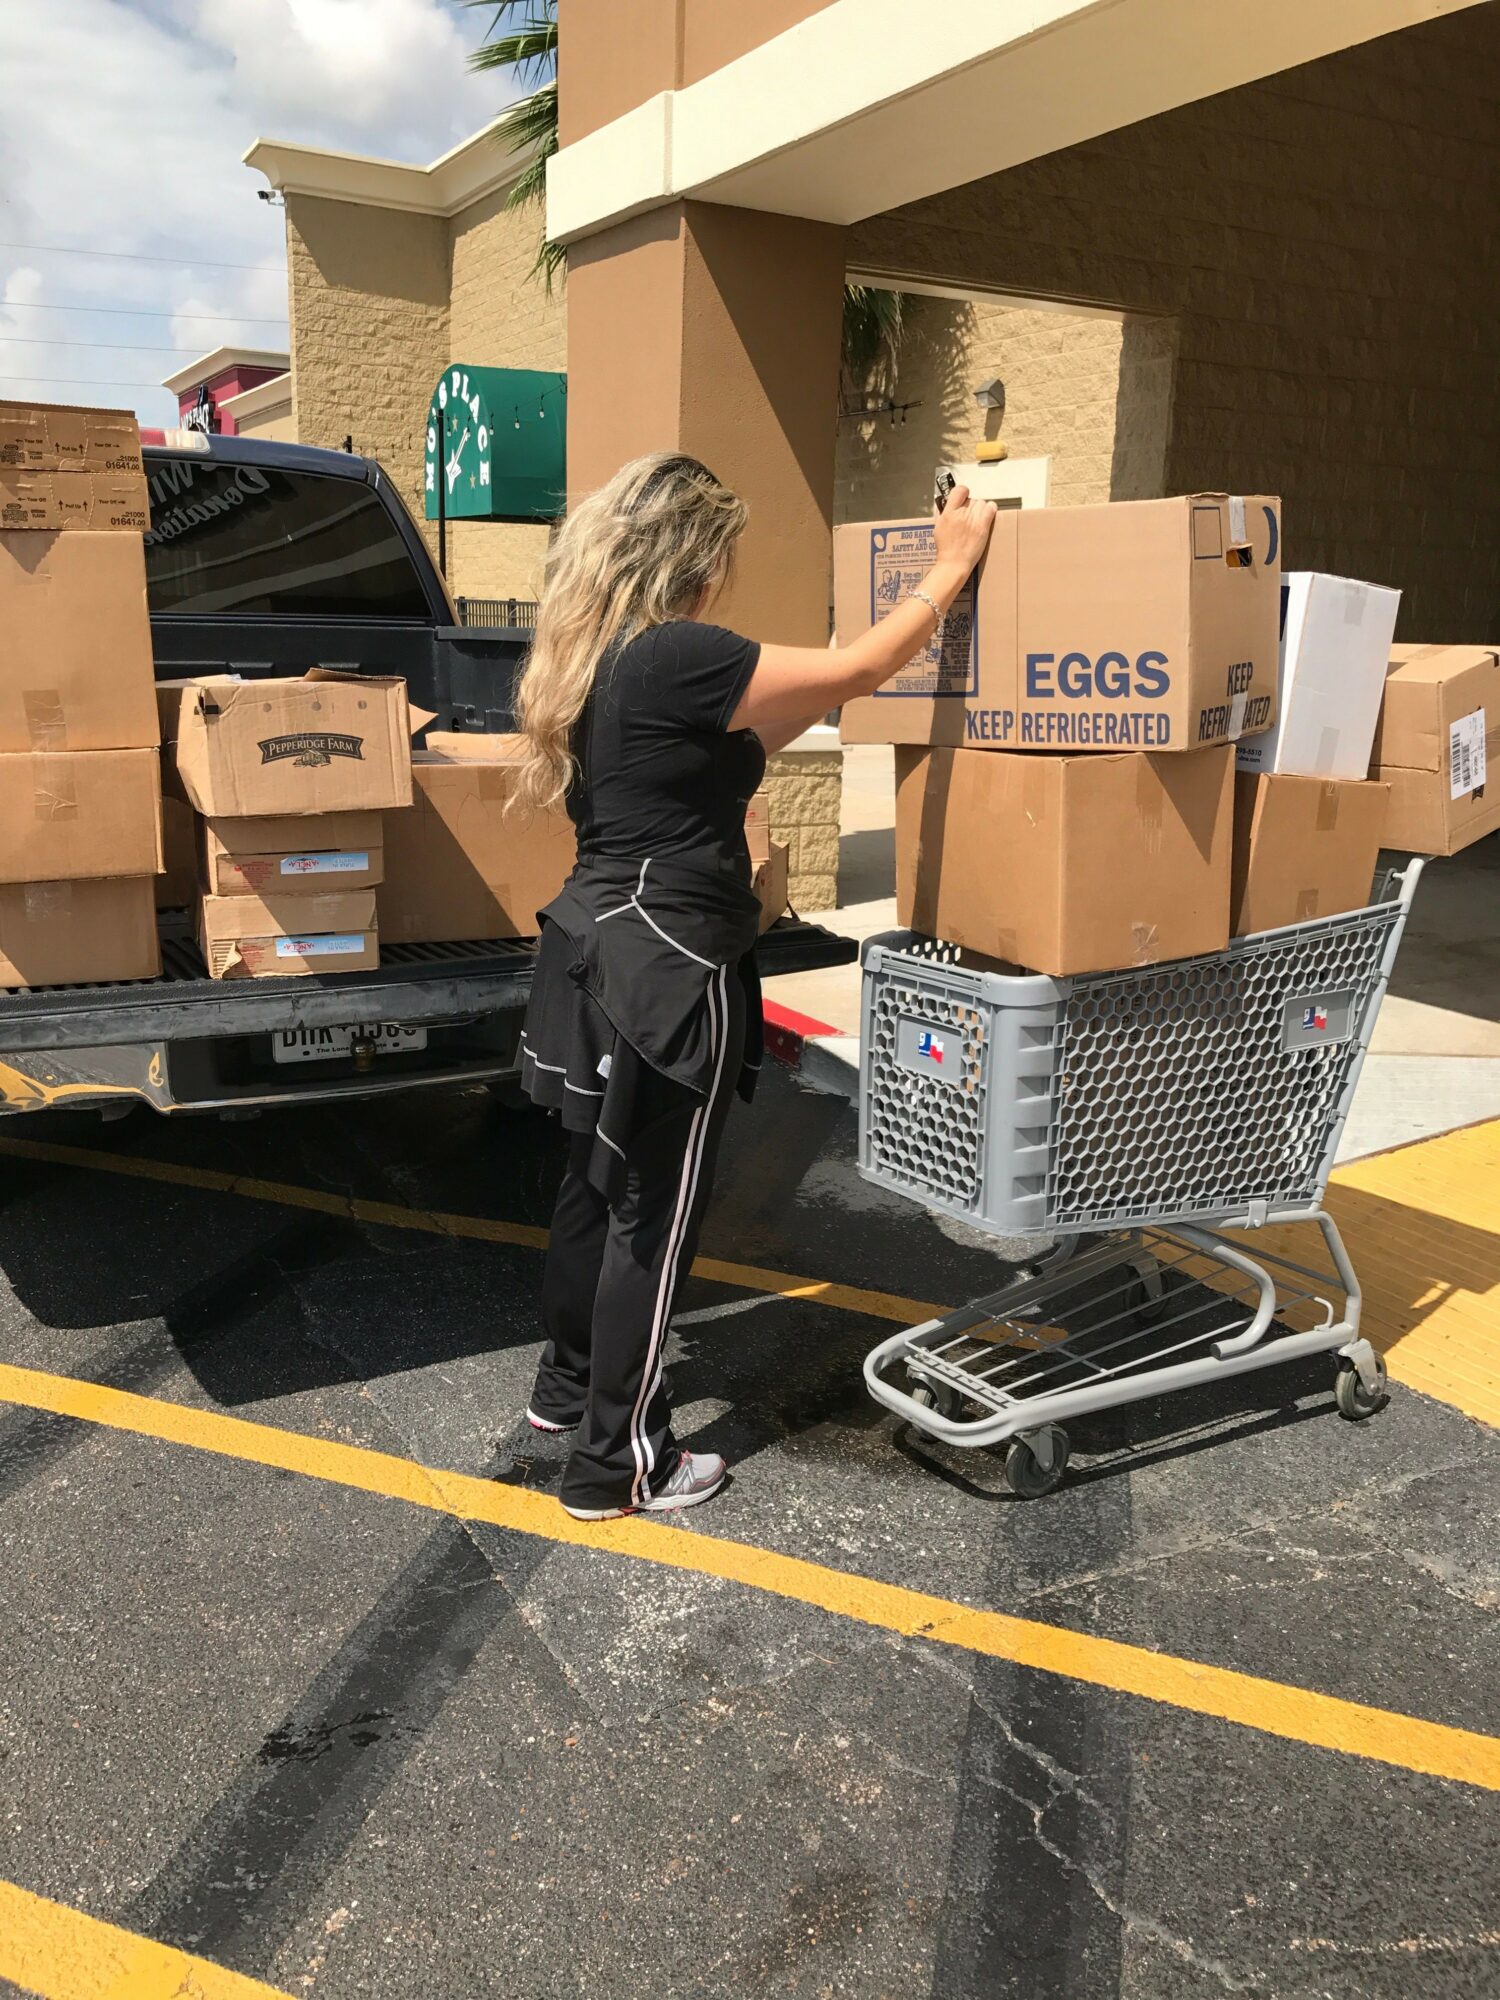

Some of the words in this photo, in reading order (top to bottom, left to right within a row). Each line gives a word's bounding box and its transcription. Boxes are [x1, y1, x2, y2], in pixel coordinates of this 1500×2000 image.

[451, 371, 490, 487] PLACE
[892, 544, 914, 553] SAFETY
[915, 543, 928, 551] AND
[1026, 651, 1170, 699] EGGS
[1226, 662, 1253, 697] KEEP
[966, 710, 1014, 740] KEEP
[1021, 712, 1170, 745] REFRIGERATED
[1198, 696, 1271, 742] REFRIATED
[268, 739, 326, 757] PEPPERIDGE
[327, 738, 354, 752] FARM
